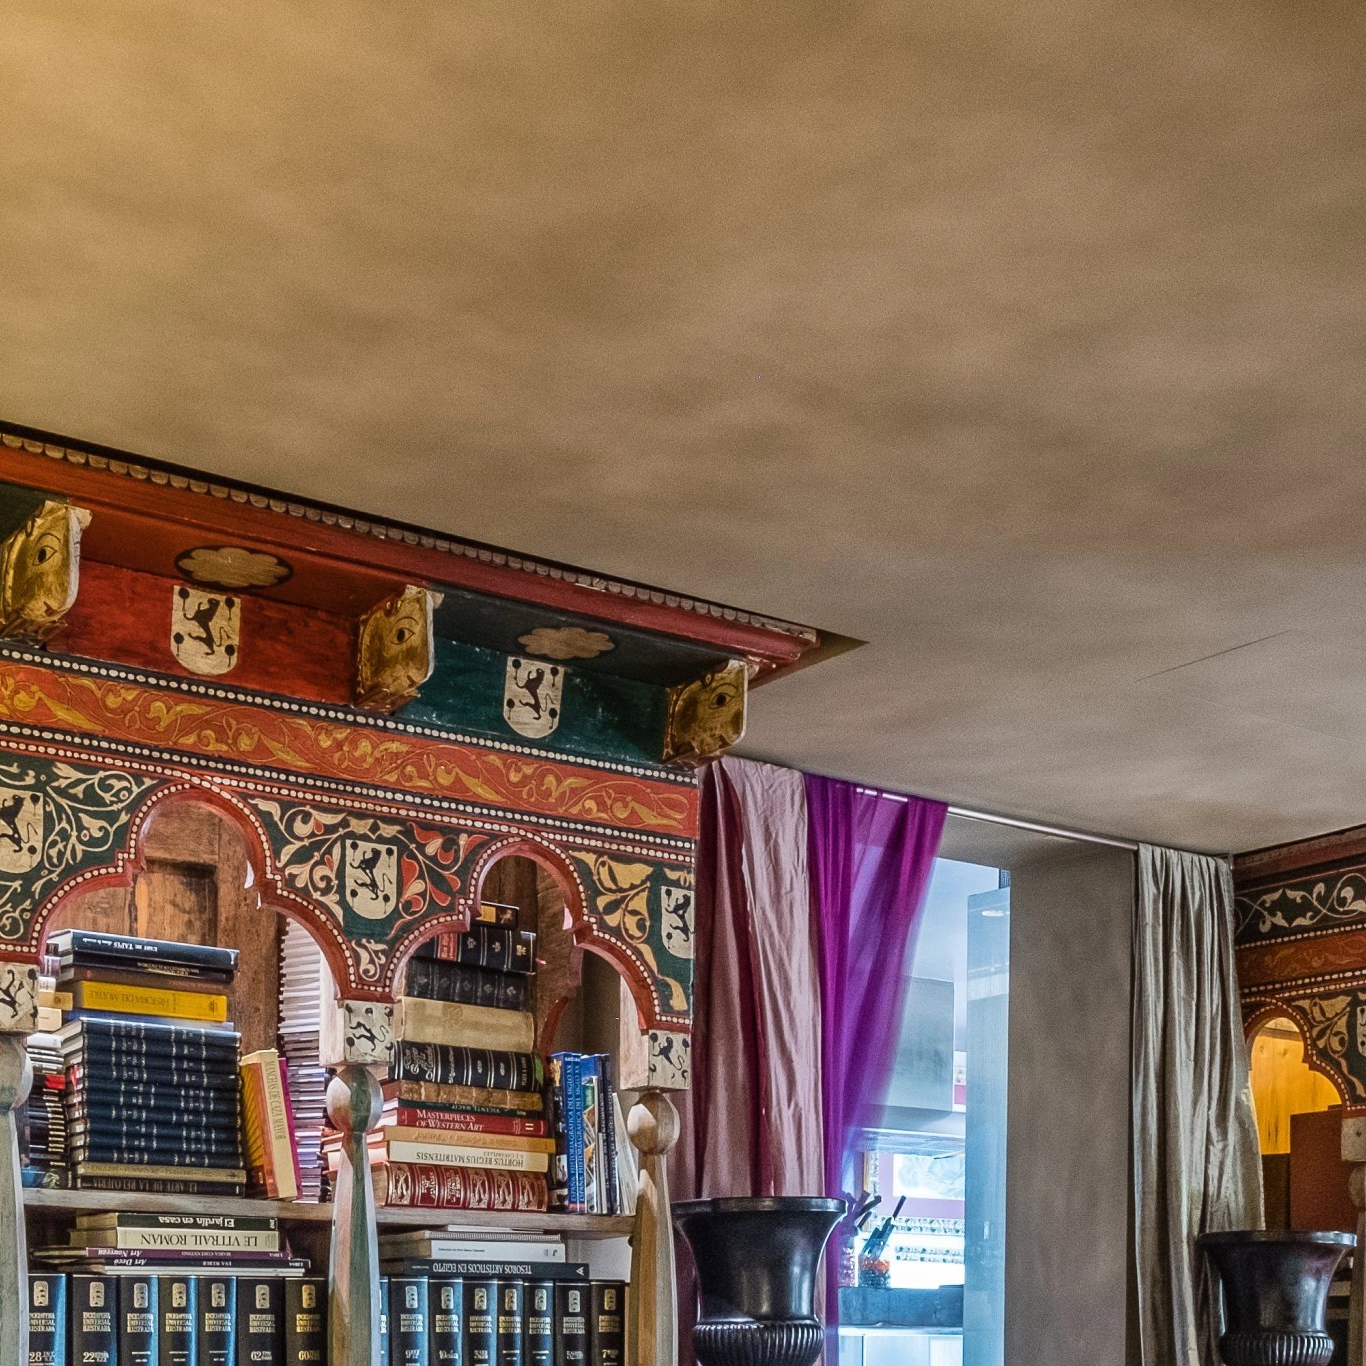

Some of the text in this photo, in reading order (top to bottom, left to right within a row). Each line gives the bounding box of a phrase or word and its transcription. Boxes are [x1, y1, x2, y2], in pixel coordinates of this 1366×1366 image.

[113, 941, 133, 950] TAPIS
[416, 1109, 476, 1122] MASTERPIECES
[428, 1119, 467, 1131] WESTERN
[468, 1121, 484, 1132] ART
[416, 1151, 523, 1167] HORTUS REGIUS MATRITENSIS
[152, 1181, 162, 1190] DE
[165, 1182, 183, 1192] ARTE
[186, 1183, 197, 1192] EL
[158, 1216, 180, 1224] casa
[196, 1216, 223, 1227] jardín
[224, 1218, 234, 1227] El
[140, 1233, 257, 1247] LE VITRAIL ROMAN
[98, 1249, 128, 1257] Nouveau
[433, 1263, 532, 1275] TESOROS ARTÍSTICOS EN EGIPTO
[29, 1352, 41, 1362] 28
[83, 1352, 95, 1362] 22
